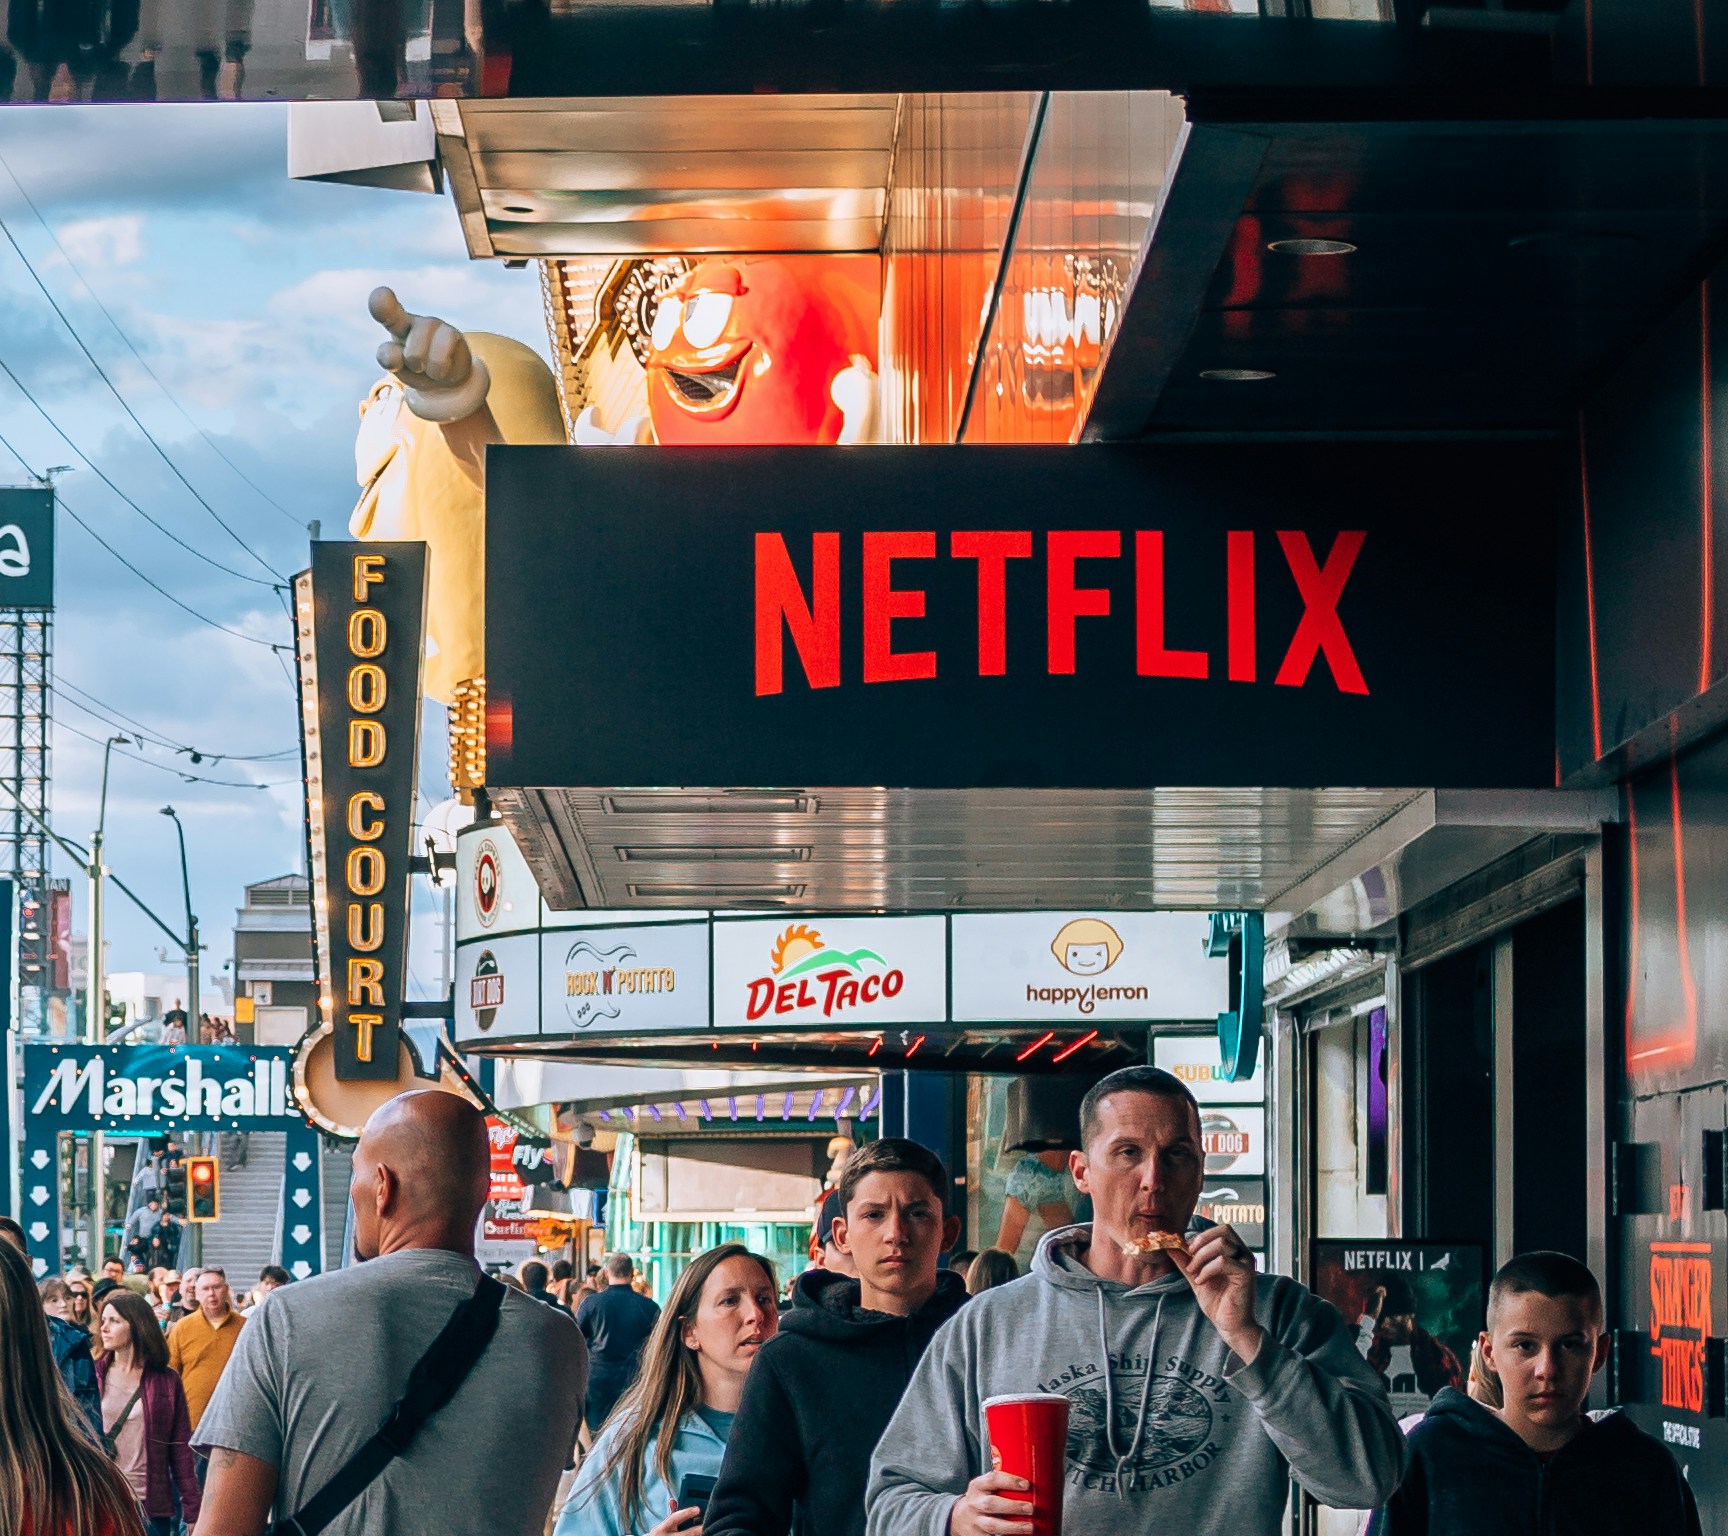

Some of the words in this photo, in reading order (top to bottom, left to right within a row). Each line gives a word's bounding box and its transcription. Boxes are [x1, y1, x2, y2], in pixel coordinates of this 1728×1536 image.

[755, 530, 1370, 697] NETFLIX
[346, 555, 388, 768] FOOD
[345, 790, 387, 1063] COURT
[565, 970, 599, 997] ROCK
[617, 966, 676, 995] POTATO
[745, 977, 818, 1021] DEL
[822, 969, 905, 1018] TACO
[513, 1144, 545, 1170] Fly
[1218, 1133, 1243, 1153] DOG
[1214, 1204, 1265, 1224] POTATO
[1344, 1250, 1412, 1271] NETFLIX
[1650, 1253, 1713, 1347] STRANGER
[1037, 1362, 1099, 1394] laska
[1165, 1354, 1232, 1404] Supply
[1660, 1336, 1705, 1413] THINGS
[1065, 1464, 1117, 1492] TCH
[1128, 1441, 1222, 1493] HARBOR
